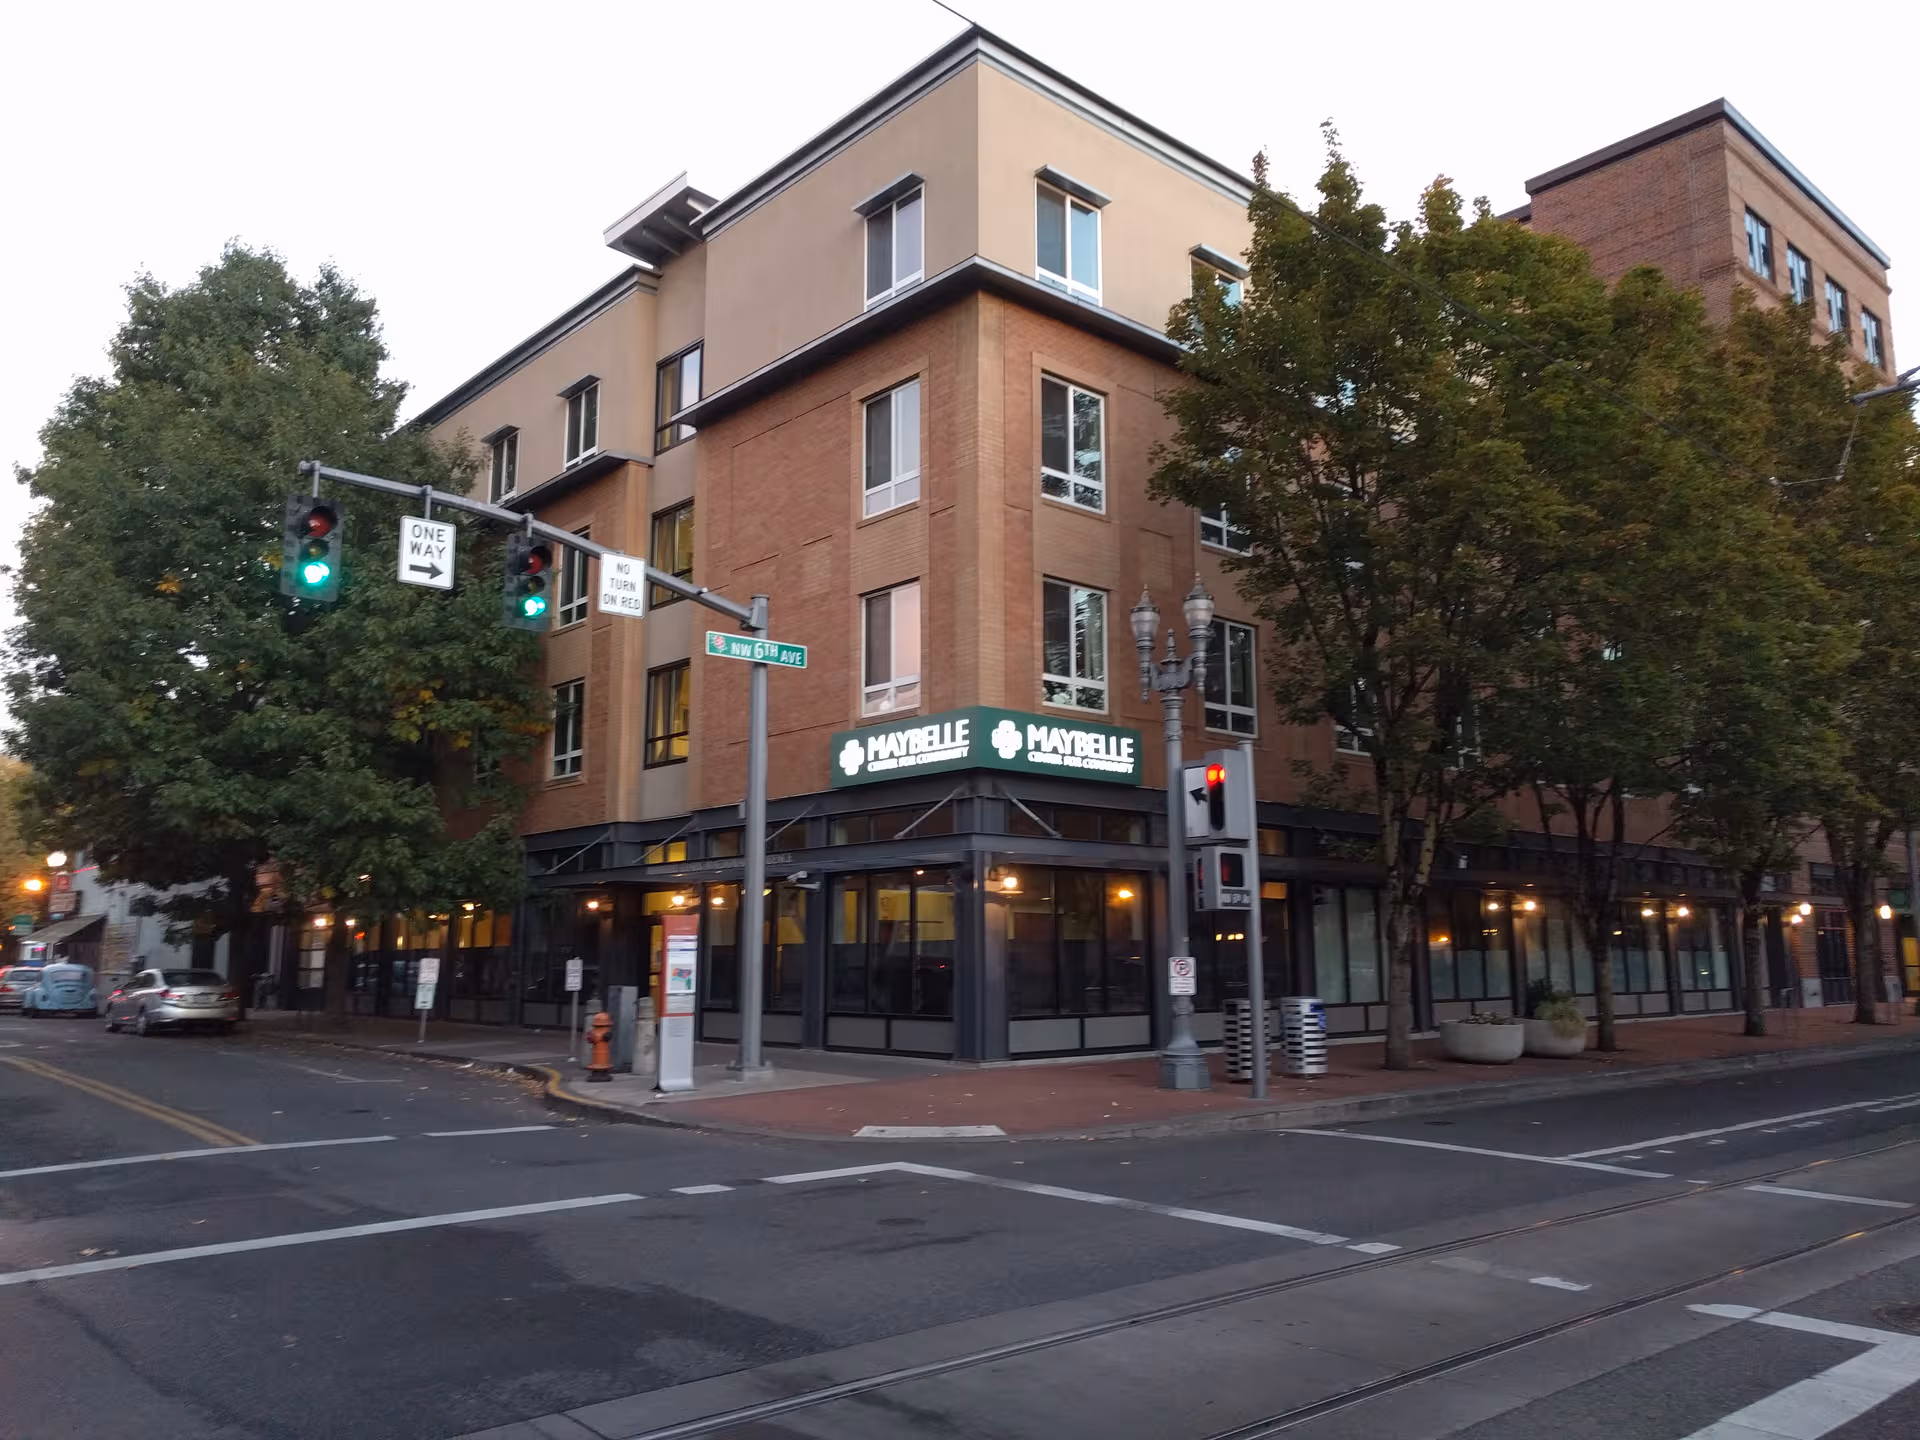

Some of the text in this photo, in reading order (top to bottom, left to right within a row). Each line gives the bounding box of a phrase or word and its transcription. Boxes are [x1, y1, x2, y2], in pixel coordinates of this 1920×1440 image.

[412, 524, 446, 543] ONE
[410, 540, 446, 560] WAY
[616, 562, 631, 575] NO
[609, 577, 637, 593] TURN
[603, 593, 641, 610] ON RED
[731, 642, 802, 665] NW 6TH AVE
[867, 719, 970, 762] MAYBELLE
[1027, 723, 1134, 763] MAYBELLE
